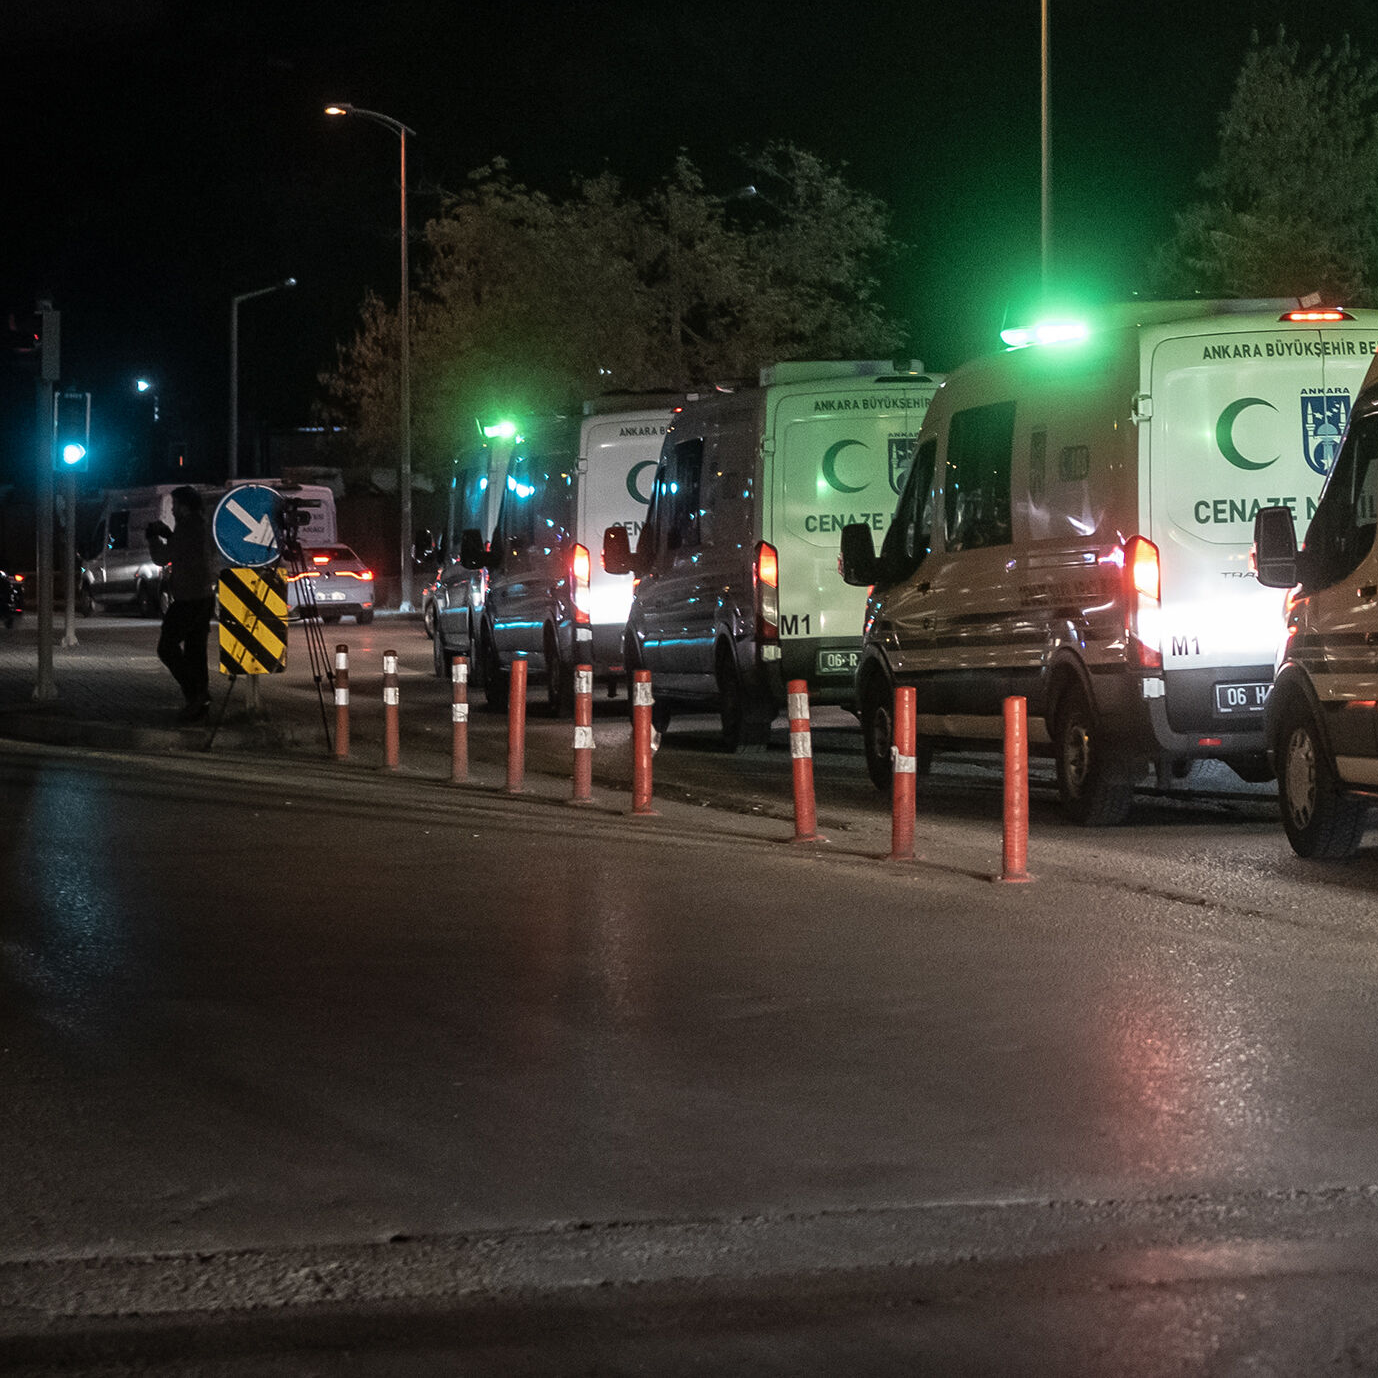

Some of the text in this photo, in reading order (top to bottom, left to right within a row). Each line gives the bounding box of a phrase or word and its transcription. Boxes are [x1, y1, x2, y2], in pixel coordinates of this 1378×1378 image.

[1202, 345, 1263, 360] ANKARA
[1266, 338, 1356, 358] BÜYÜKŞEHİR
[1300, 387, 1350, 395] ANKARA
[814, 399, 860, 413] ANKARA
[619, 426, 658, 437] ANKARA
[780, 614, 811, 635] M1
[1171, 635, 1200, 656] M1
[828, 654, 842, 667] 06
[1227, 686, 1265, 705] 06 H
